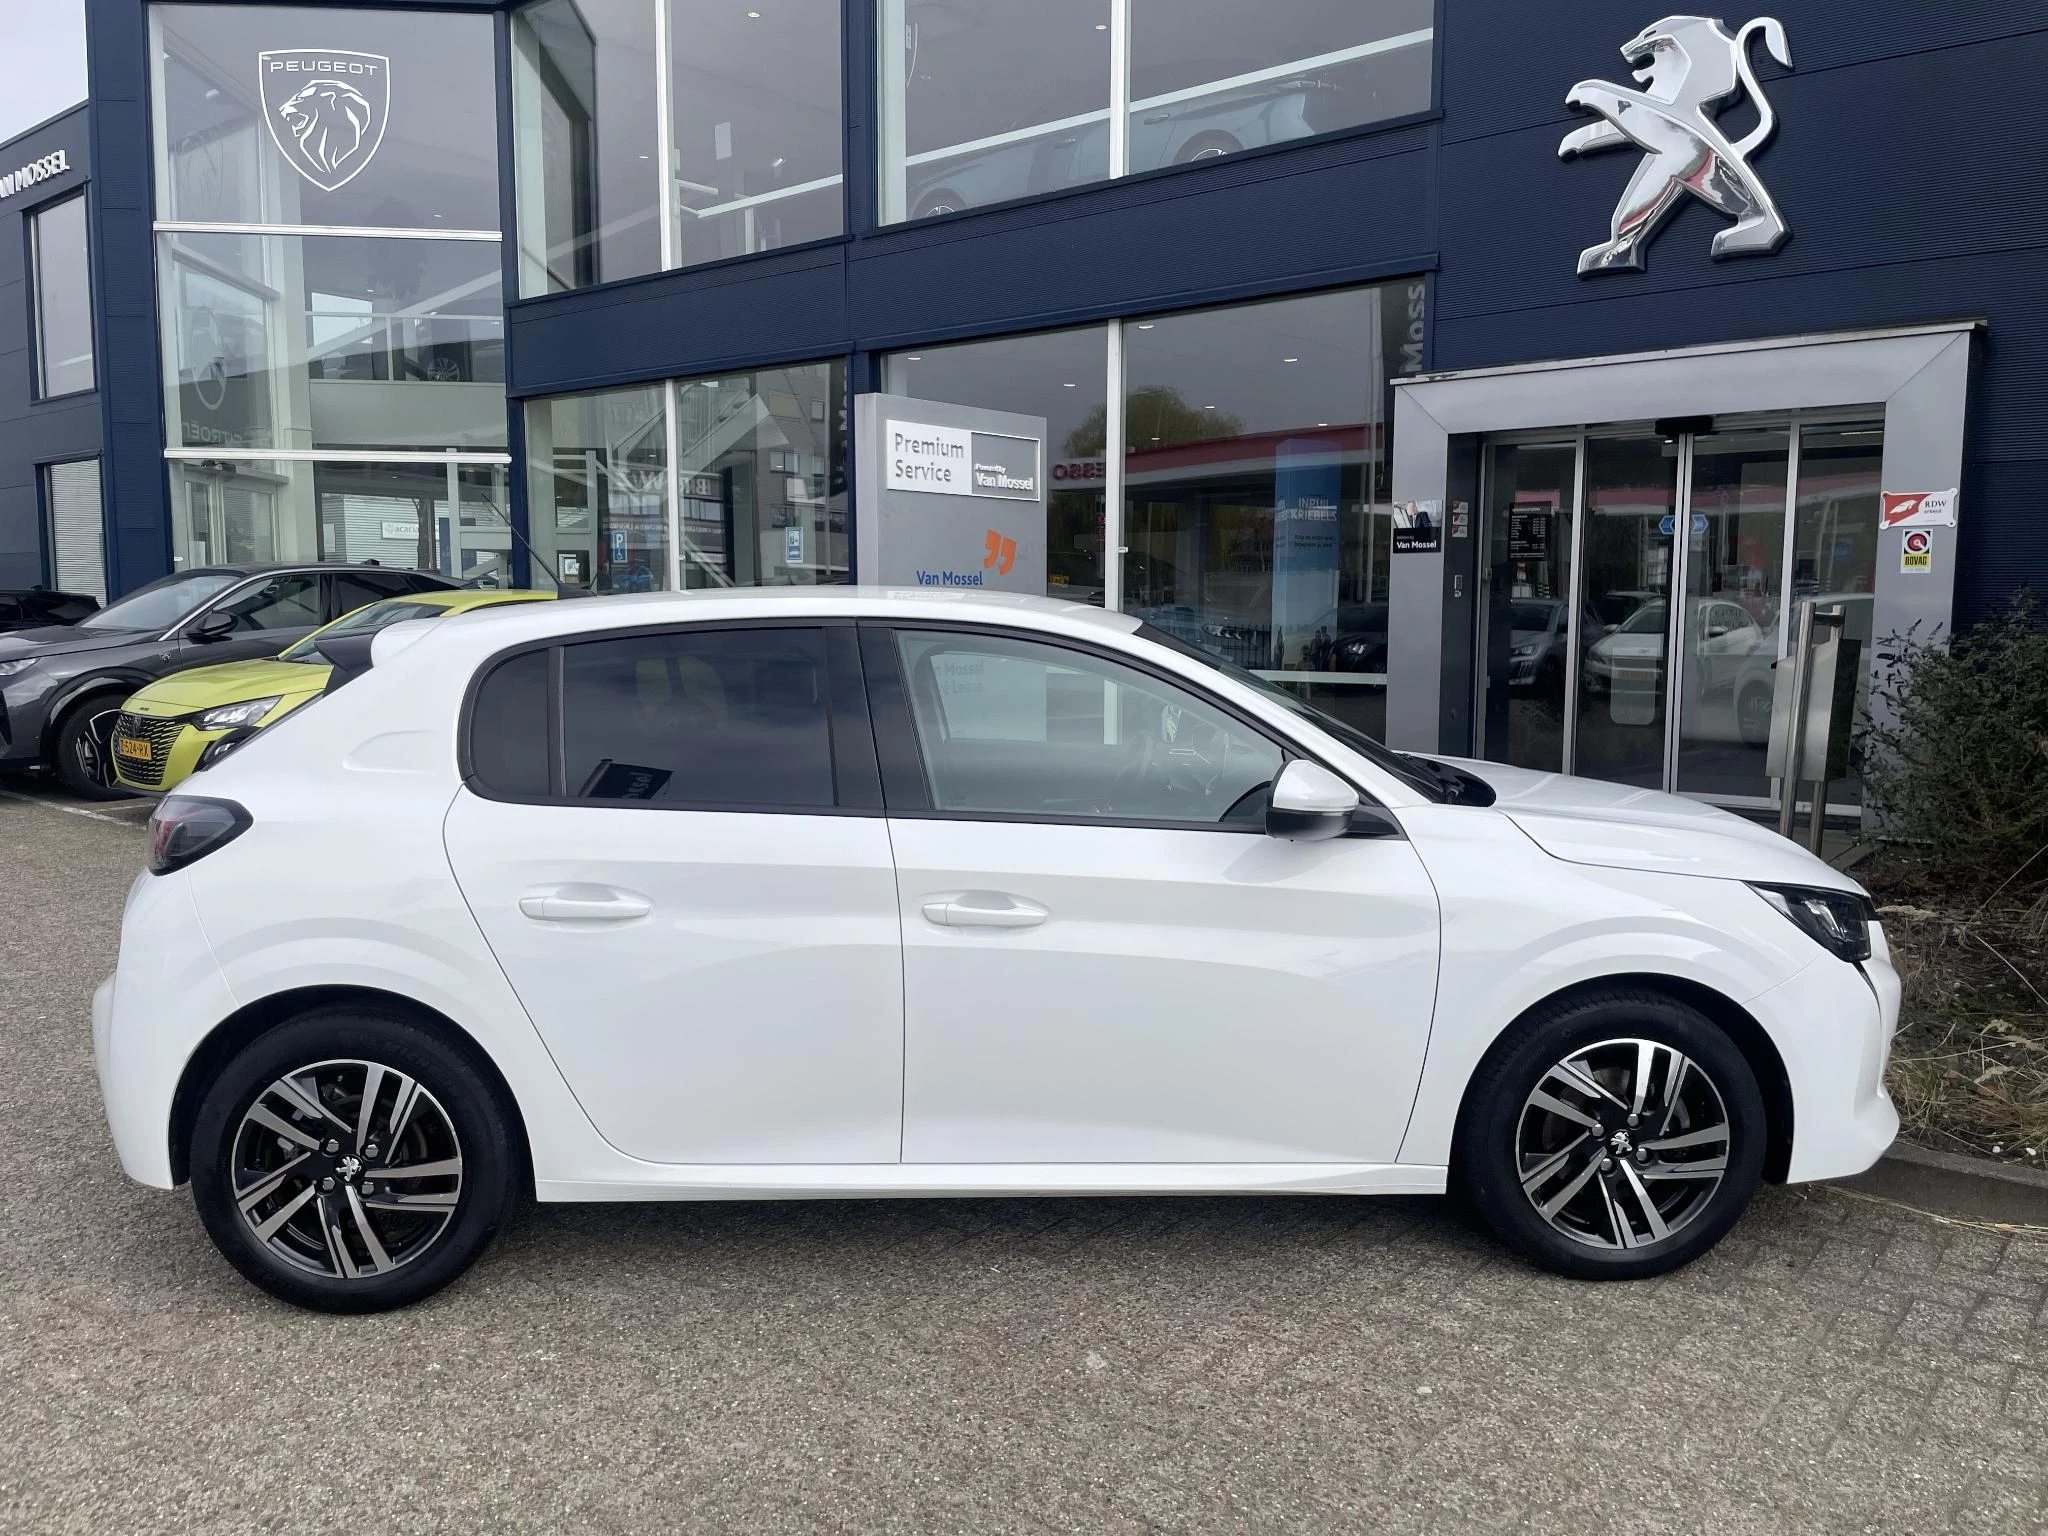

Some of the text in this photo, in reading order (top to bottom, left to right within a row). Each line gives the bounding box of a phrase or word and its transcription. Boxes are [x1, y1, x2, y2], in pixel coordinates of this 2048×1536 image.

[270, 60, 378, 76] PEUGEOT
[15, 149, 70, 192] MOSSEL
[895, 432, 965, 459] Premium
[896, 459, 952, 483] Service
[976, 472, 1034, 491] Van Mossel
[1925, 500, 1947, 508] RDW
[1396, 540, 1437, 549] Van Mossel
[916, 570, 983, 586] Van Mossel
